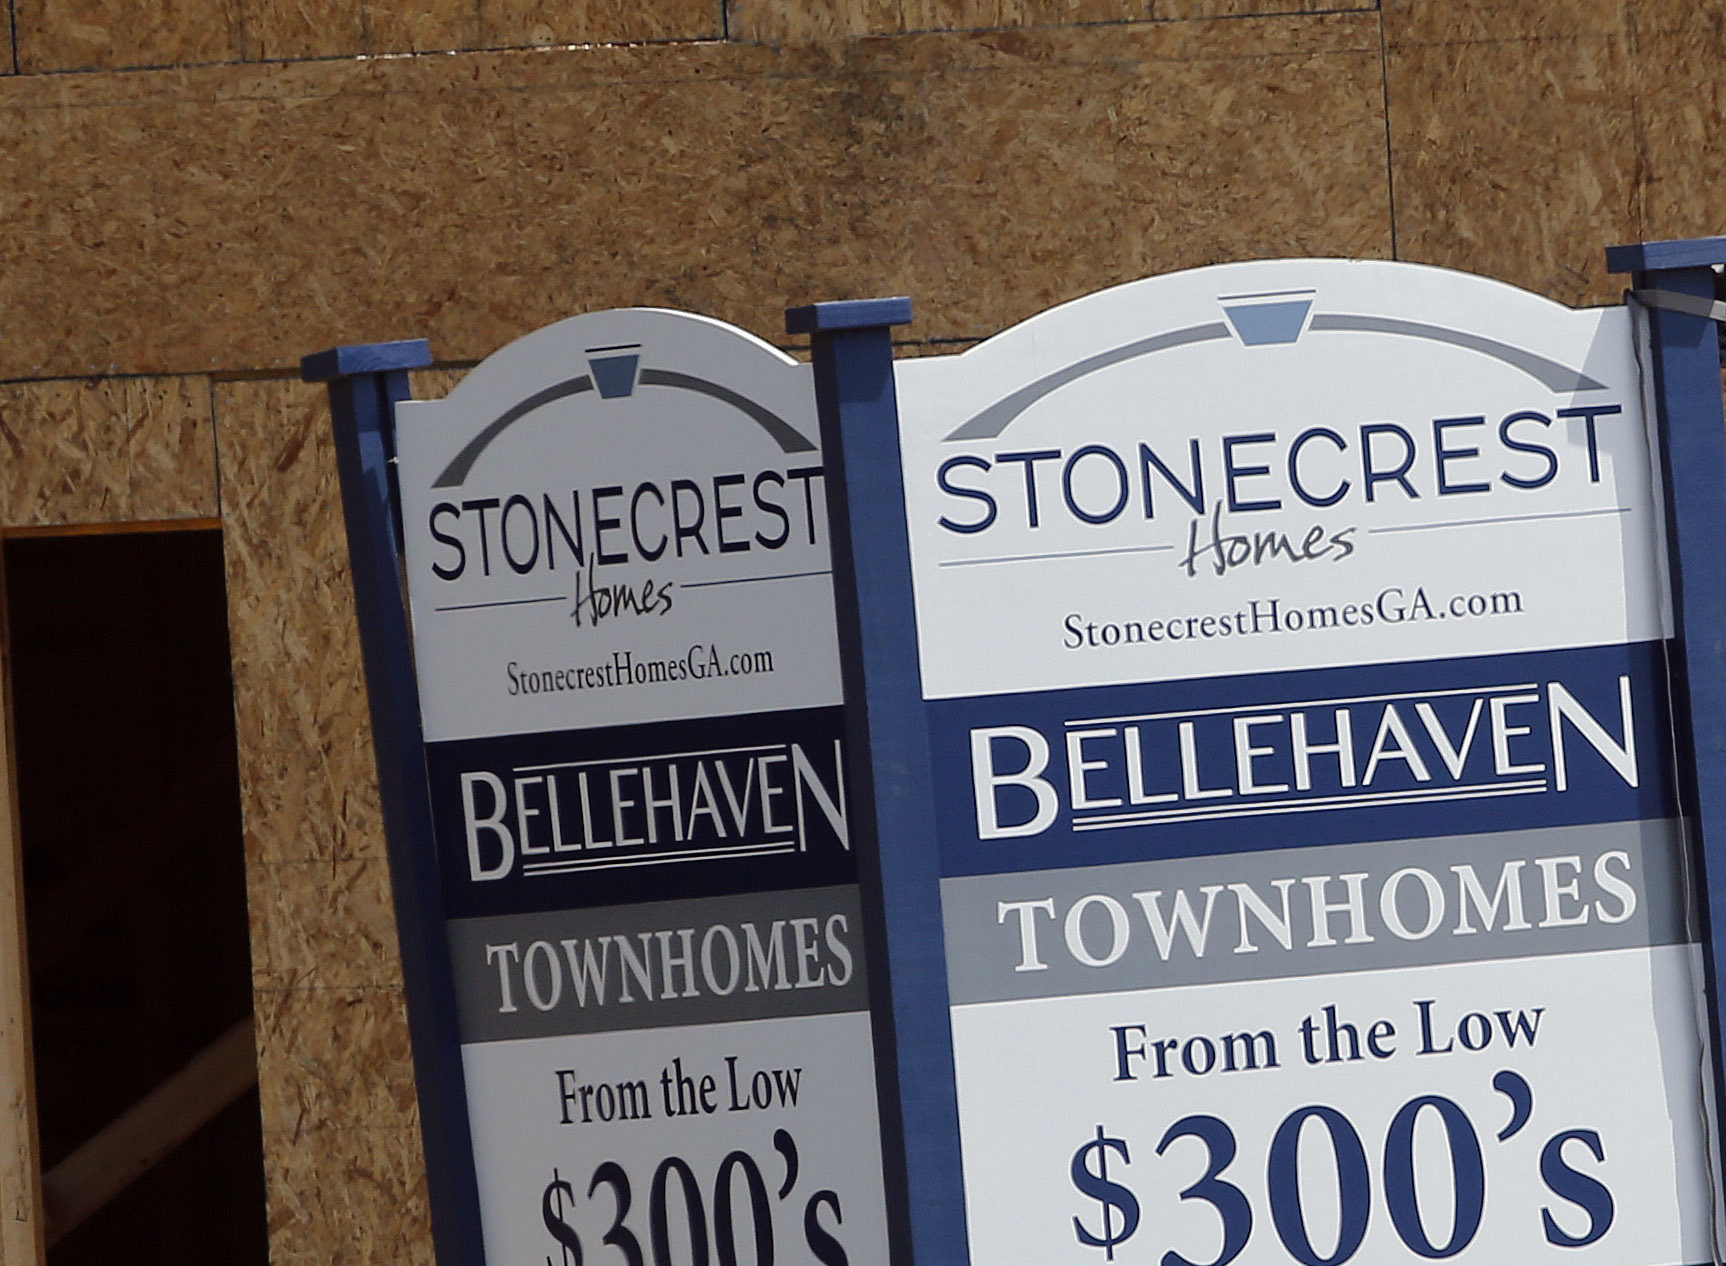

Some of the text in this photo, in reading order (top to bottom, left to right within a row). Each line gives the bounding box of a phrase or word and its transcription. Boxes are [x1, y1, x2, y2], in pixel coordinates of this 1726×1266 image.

[936, 402, 1623, 536] STONECREST
[429, 466, 825, 581] STONECREST
[1179, 500, 1357, 578] Homes
[570, 551, 673, 627] Homes
[1063, 586, 1525, 650] StonecrestHomesGA.com
[506, 643, 775, 697] StonecrestHomesGA.com
[970, 674, 1640, 840] BELLEHAVEN
[460, 739, 850, 882] BELLEHAVEN
[997, 849, 1638, 973] TOWNHOMES
[486, 913, 854, 1013] TOWNHOMES
[1110, 998, 1546, 1081] From the Low
[555, 1055, 803, 1125] From the Low
